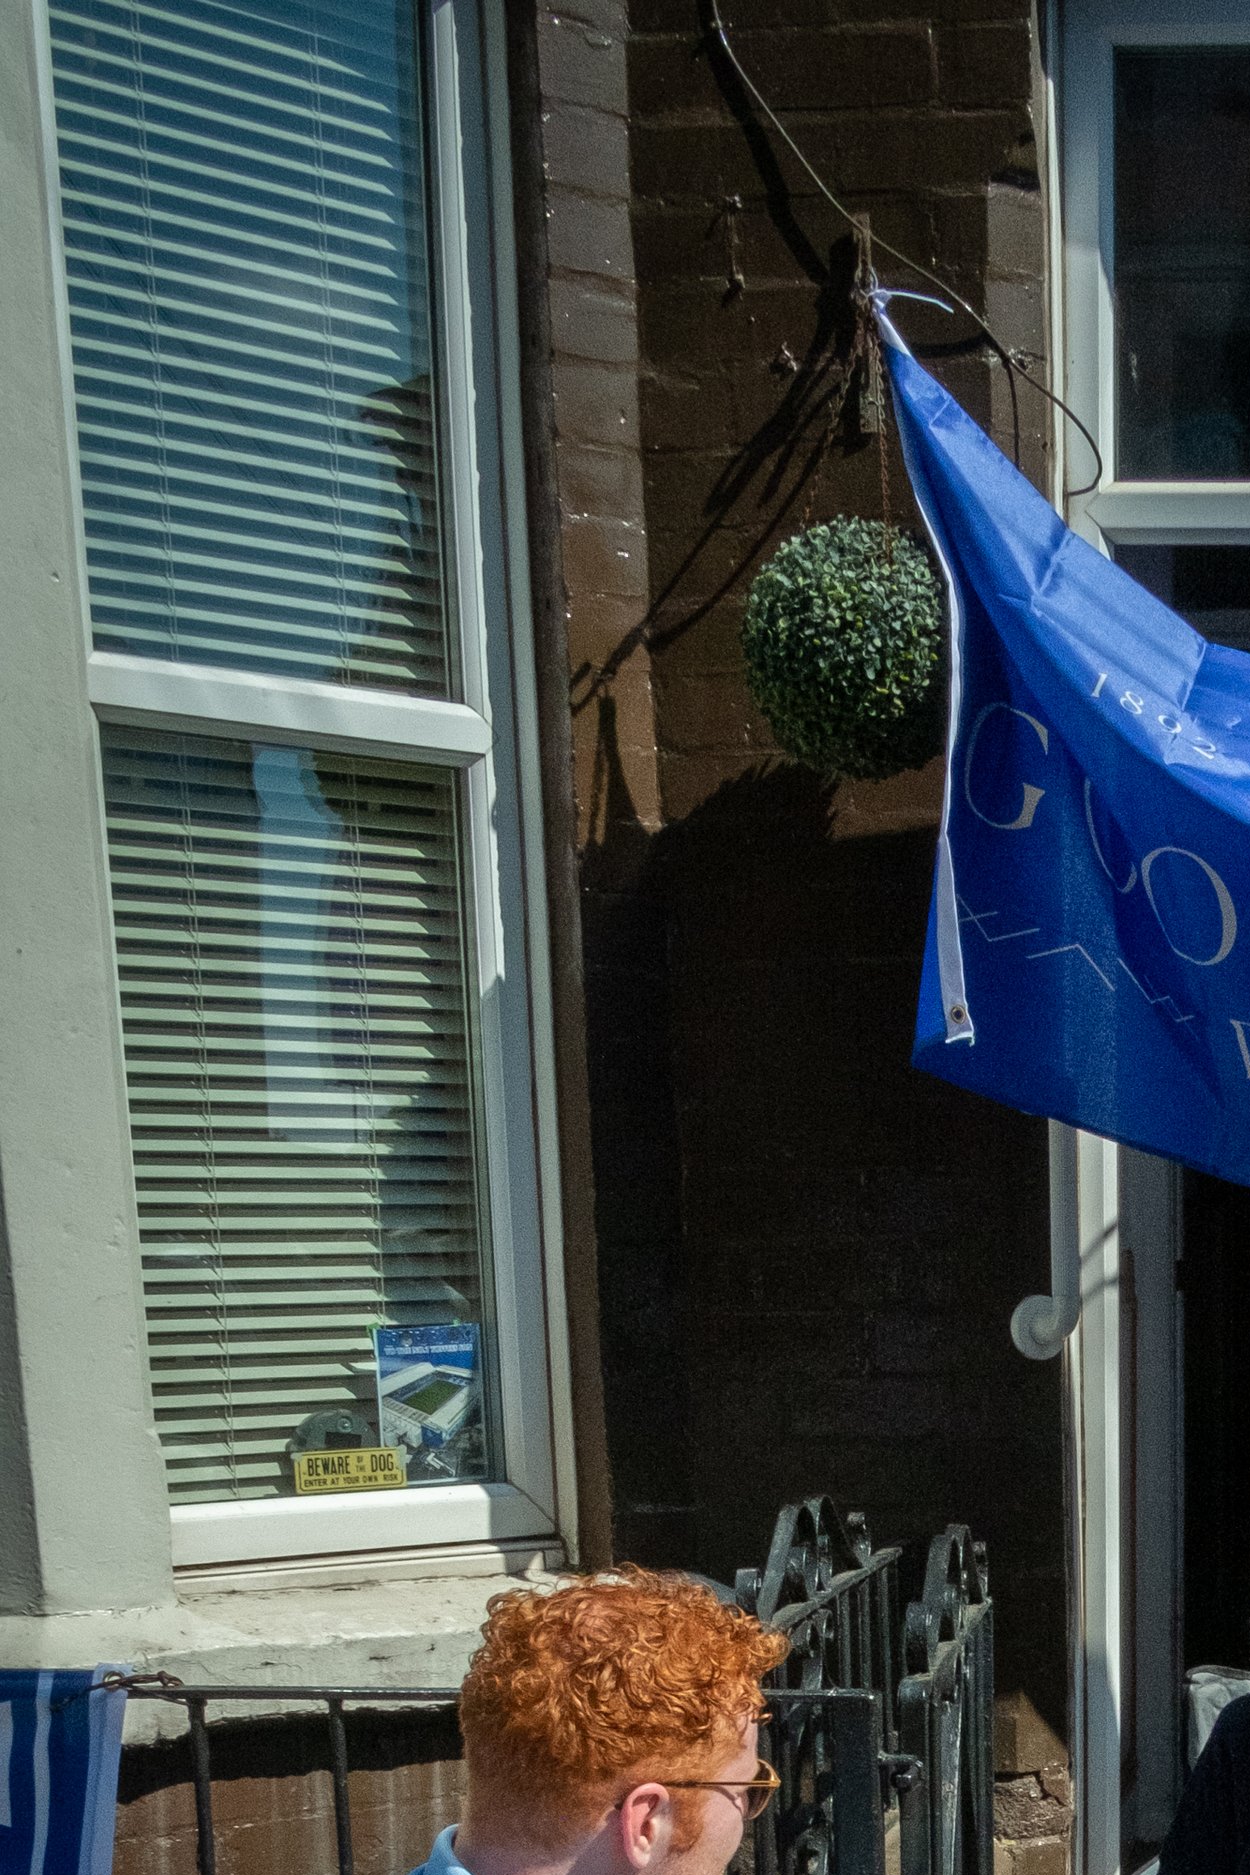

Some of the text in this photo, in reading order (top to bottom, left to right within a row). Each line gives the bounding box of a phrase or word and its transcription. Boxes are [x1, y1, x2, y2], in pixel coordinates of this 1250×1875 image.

[306, 1455, 351, 1477] BEWARE
[370, 1453, 394, 1472] DOG
[304, 1473, 398, 1488] ENTER AT YOUR OWN RISK
